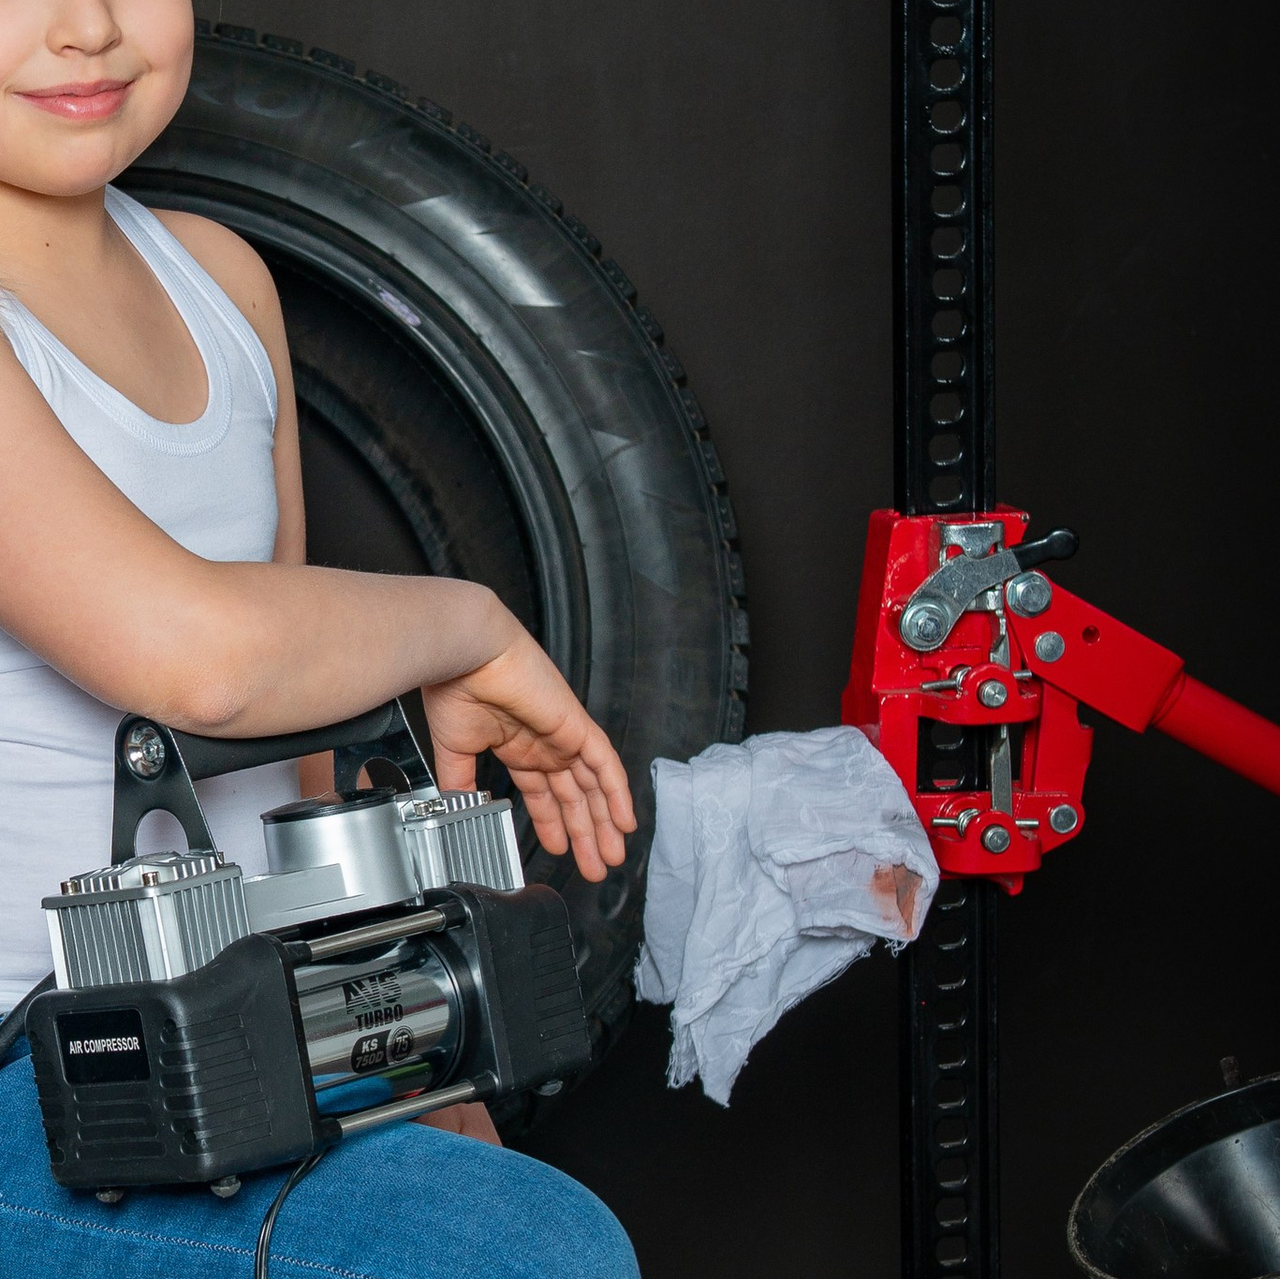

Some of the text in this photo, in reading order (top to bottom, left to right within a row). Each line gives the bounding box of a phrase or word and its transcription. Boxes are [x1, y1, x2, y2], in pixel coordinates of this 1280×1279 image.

[355, 1004, 404, 1031] TURBO
[69, 1036, 140, 1054] AIR COMPRESSOR
[361, 1038, 379, 1054] KS
